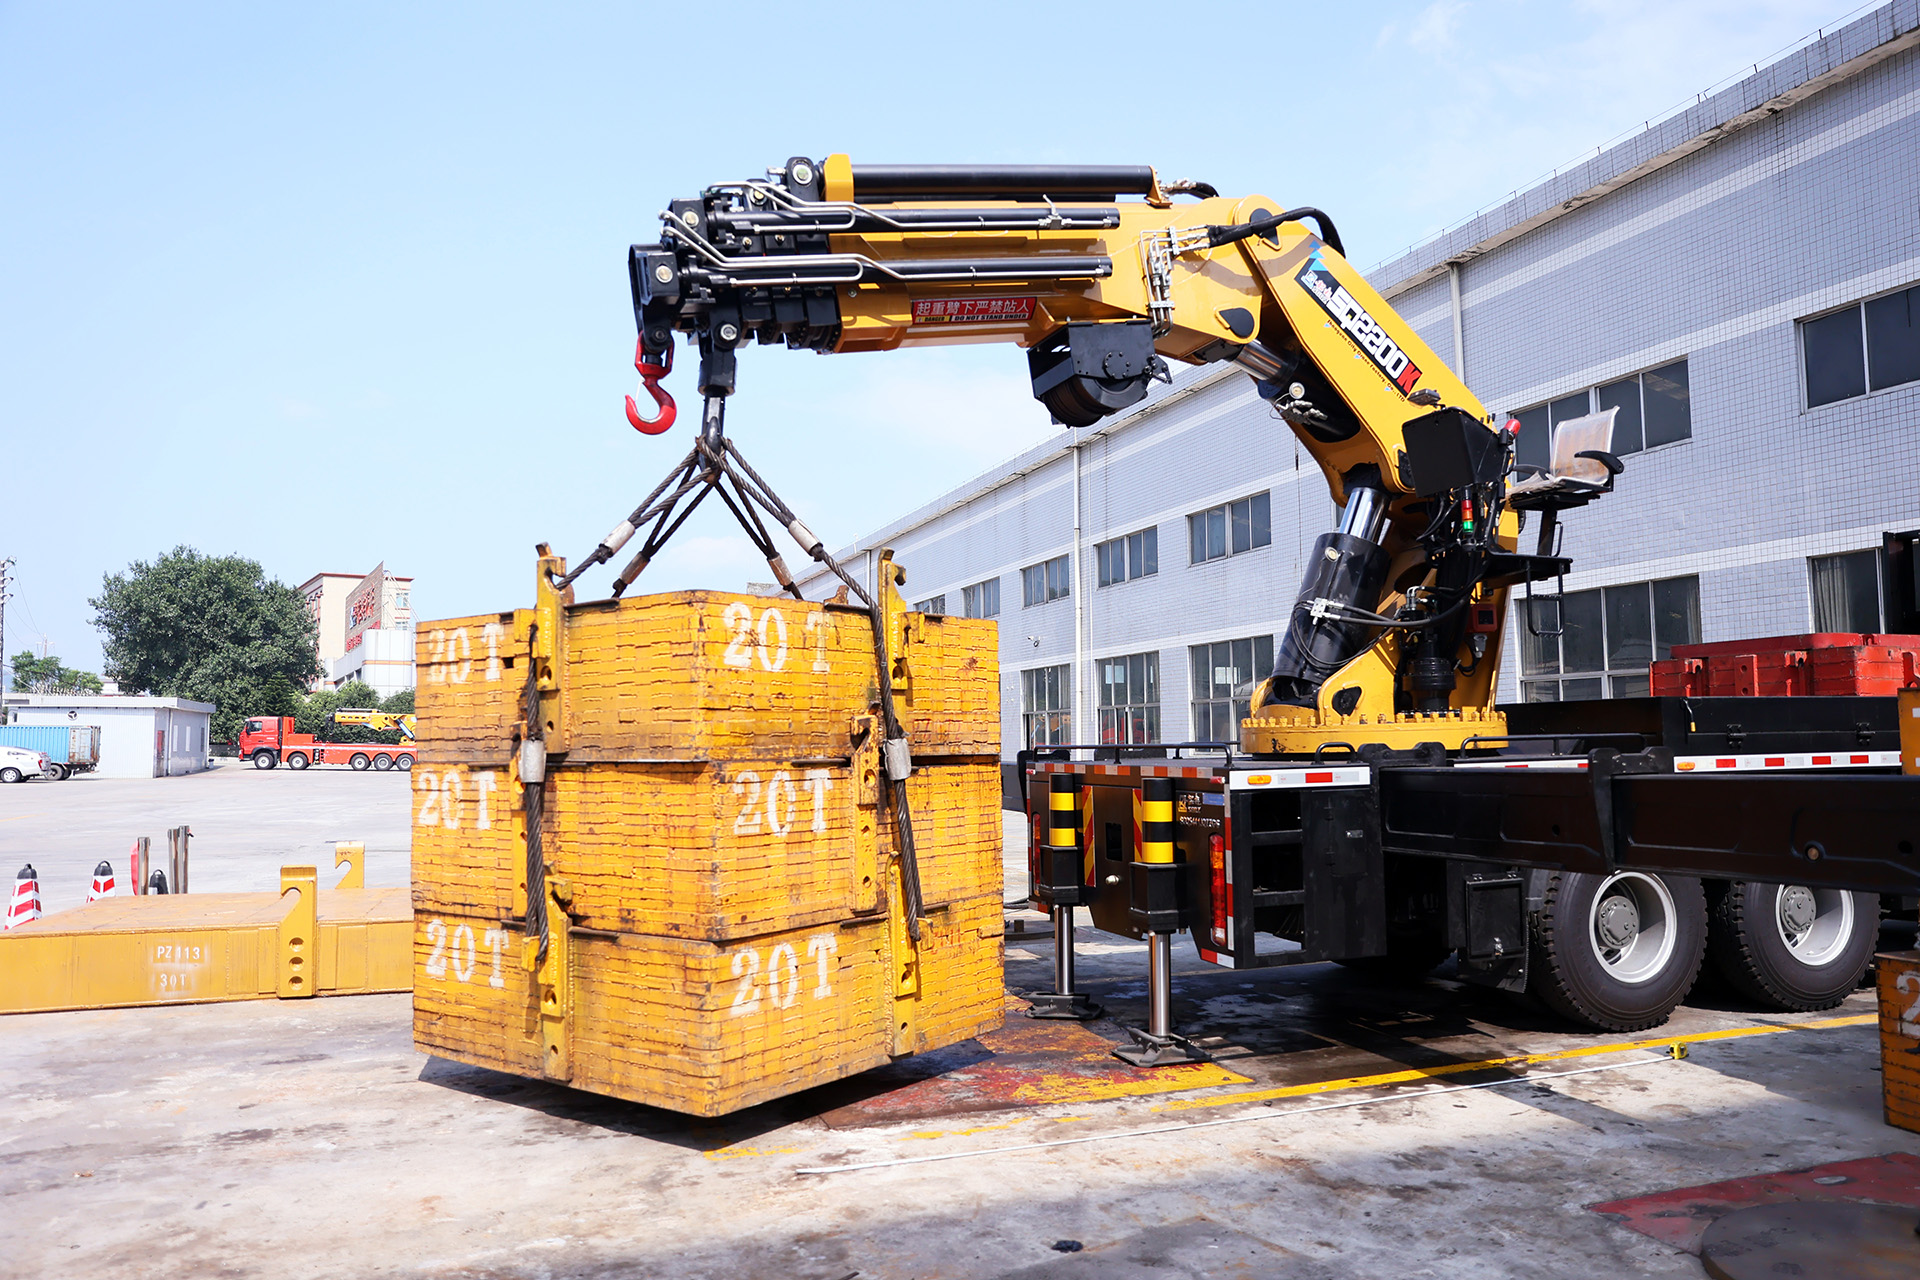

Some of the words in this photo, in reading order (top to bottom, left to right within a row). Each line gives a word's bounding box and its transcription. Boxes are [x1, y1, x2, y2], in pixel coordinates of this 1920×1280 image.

[916, 299, 1029, 316] 起重臂下严禁站人
[1326, 286, 1422, 394] SQ2200K
[418, 769, 497, 830] 20T
[733, 769, 834, 837] 20T
[160, 973, 187, 988] 30T
[426, 918, 510, 988] 20T
[730, 932, 838, 1016] 20T
